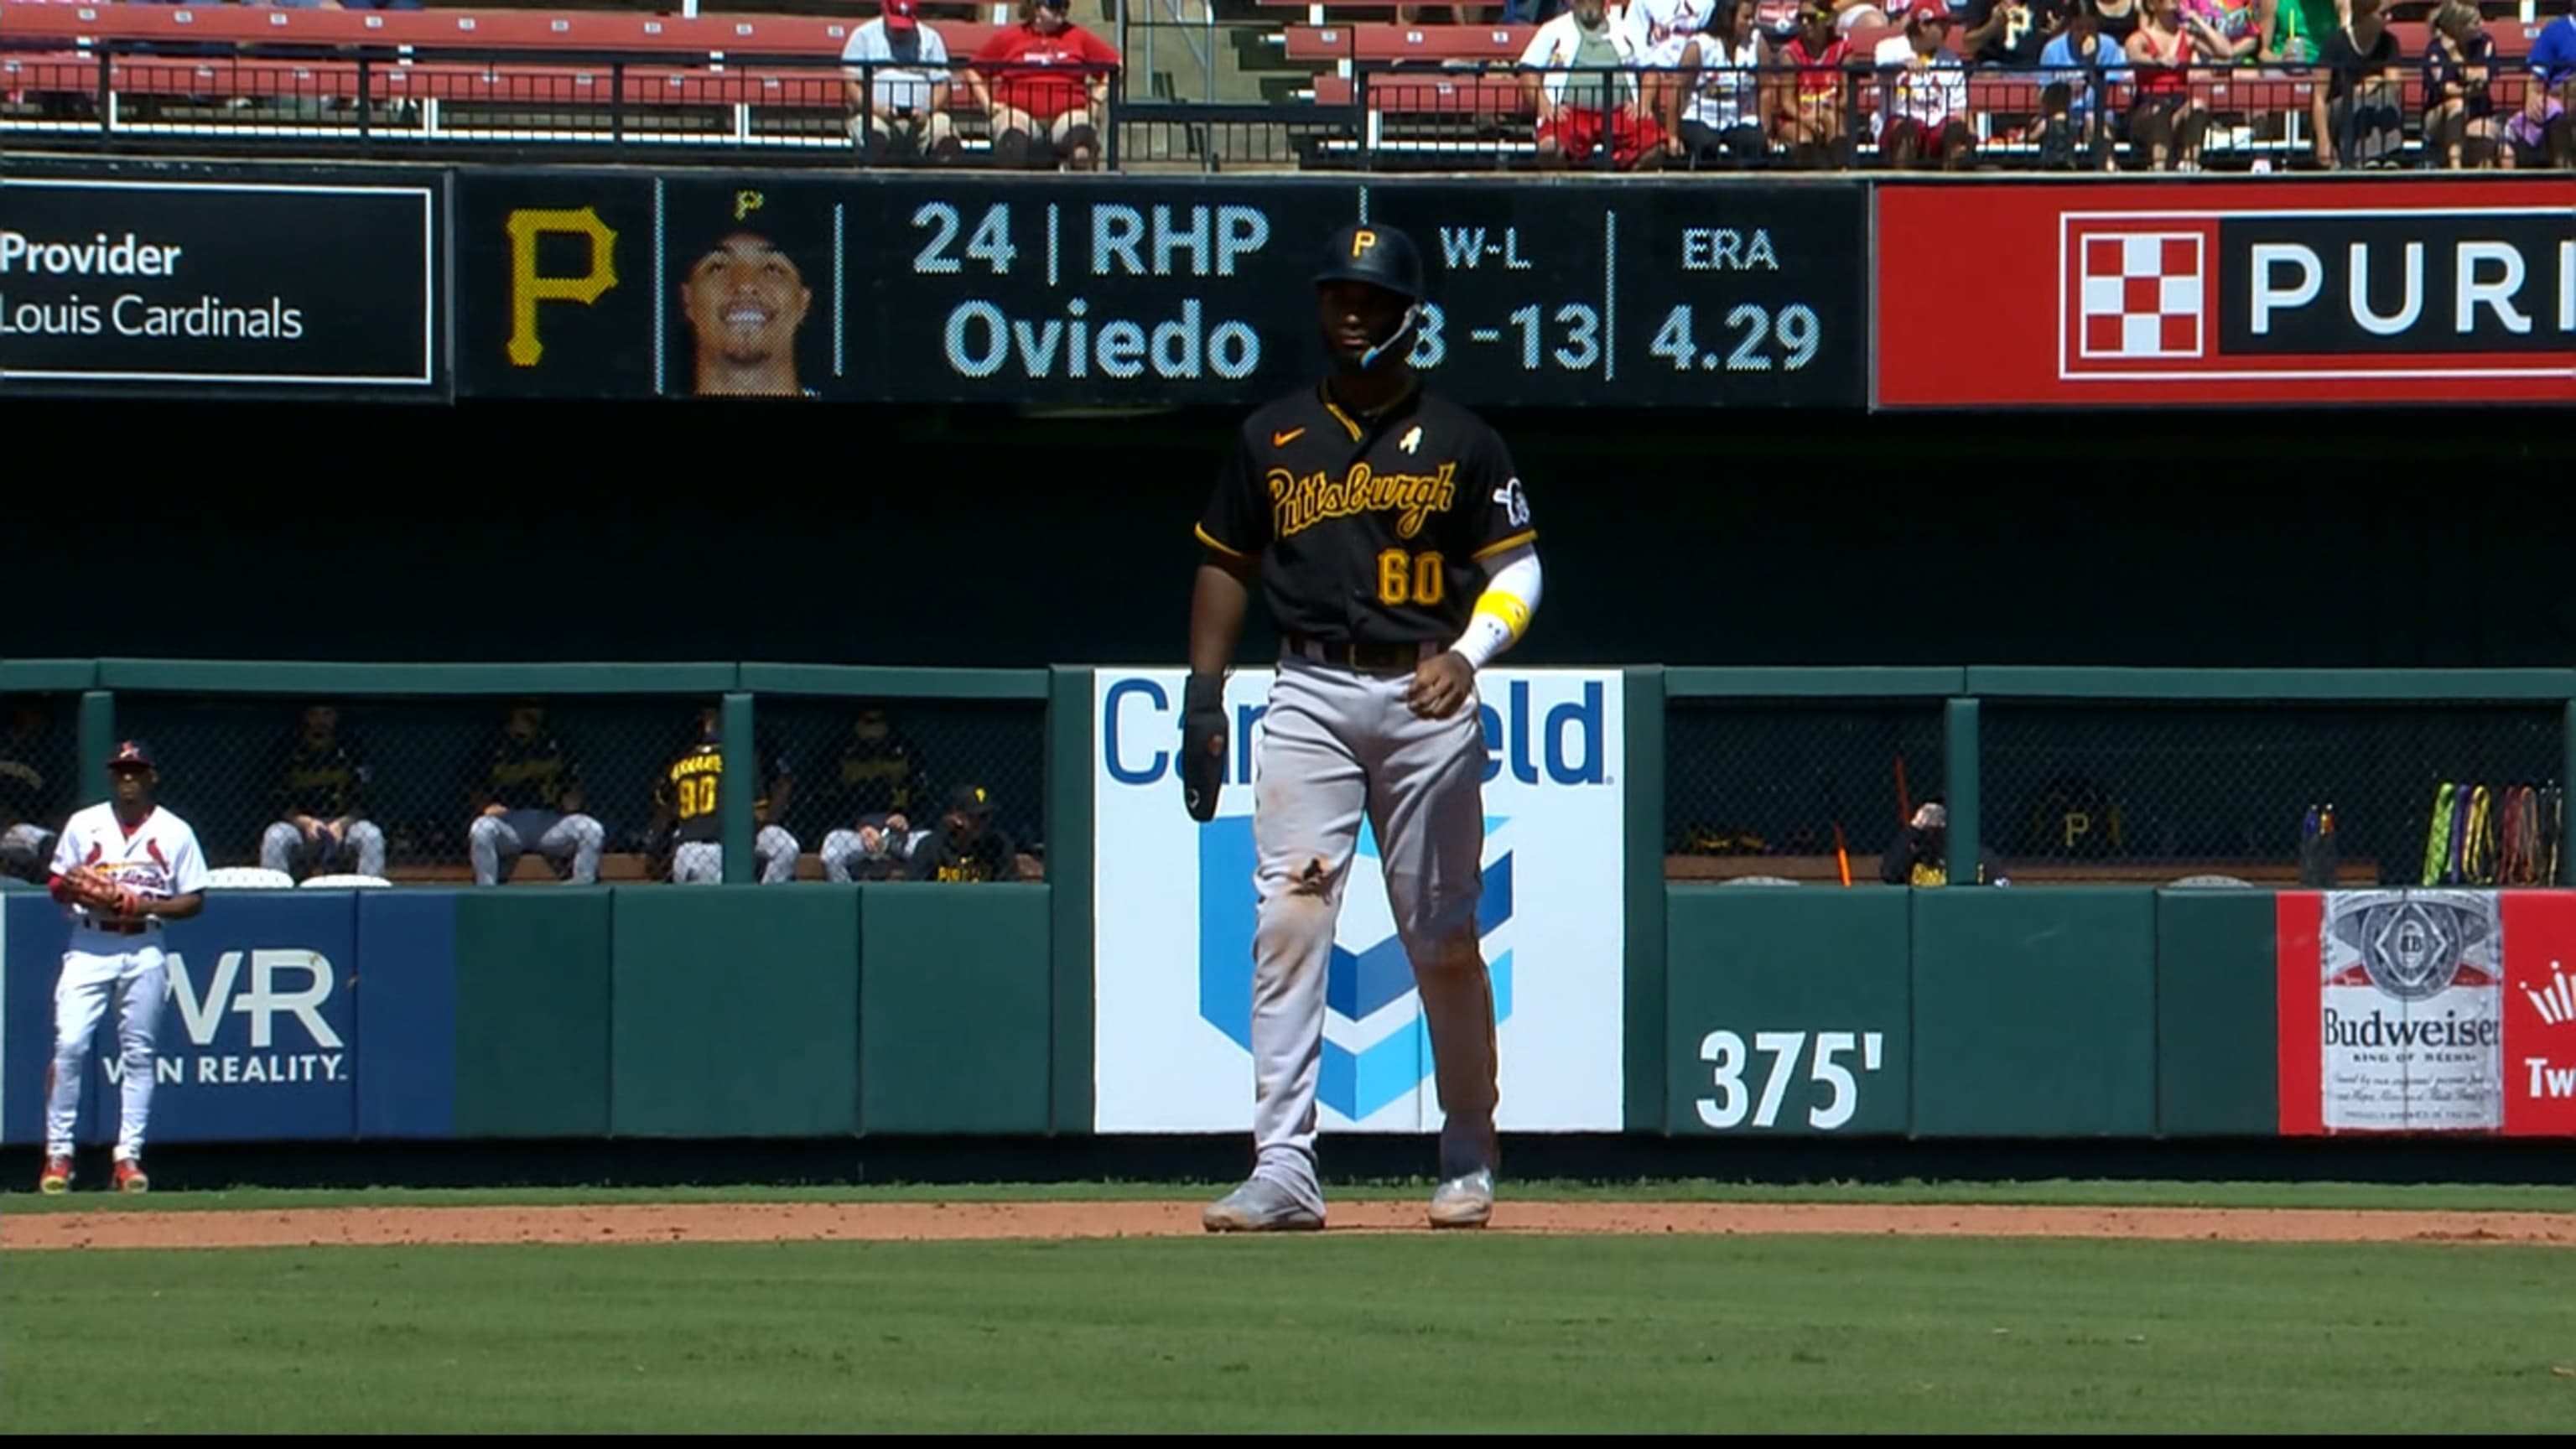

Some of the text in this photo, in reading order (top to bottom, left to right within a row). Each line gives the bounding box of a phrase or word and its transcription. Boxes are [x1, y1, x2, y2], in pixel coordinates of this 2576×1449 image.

[0, 231, 182, 275] Provider
[911, 201, 1016, 274] 24
[1090, 203, 1270, 277] RHP
[1353, 231, 1376, 257] P
[1440, 227, 1533, 269] W-L
[1682, 228, 1779, 270] ERA
[507, 206, 618, 366] P
[112, 294, 304, 339] Cardinals
[945, 298, 1260, 379] Oviedo
[1649, 304, 1821, 371] 4.29
[1266, 462, 1457, 541] Pittsburgh
[1378, 548, 1444, 606] 60
[102, 1057, 184, 1084] WN
[1696, 1031, 1883, 1130] 375'
